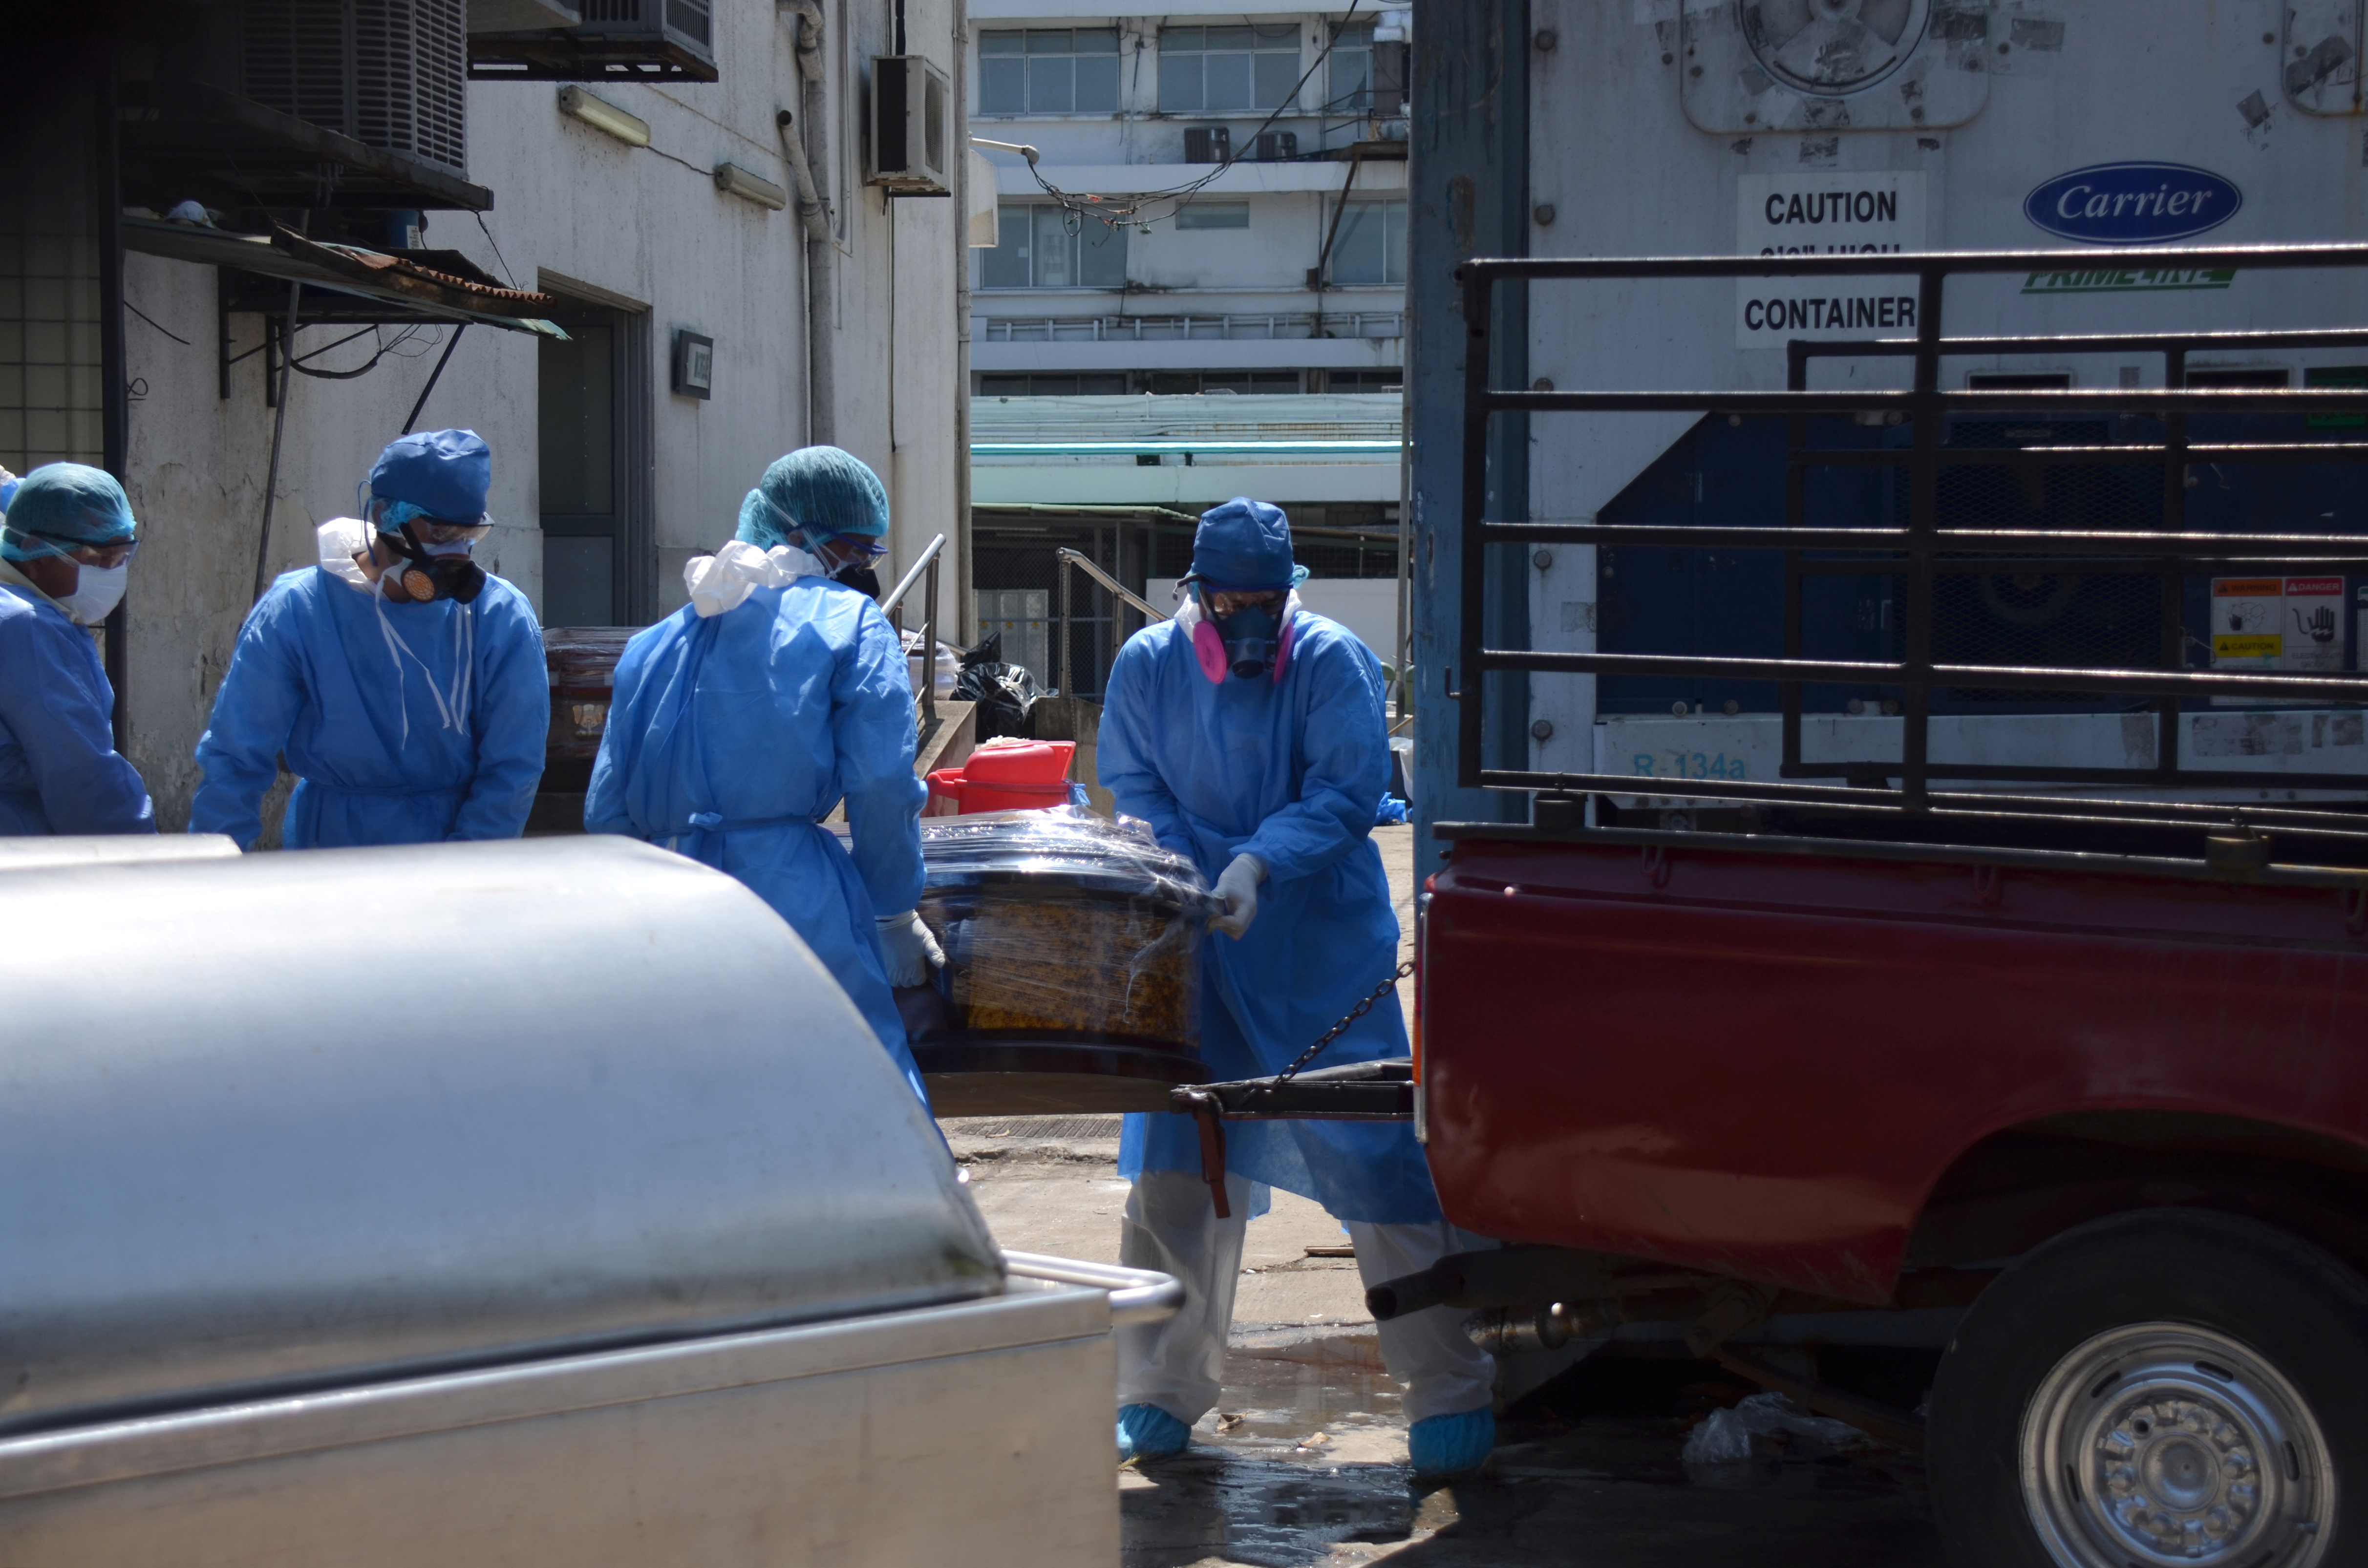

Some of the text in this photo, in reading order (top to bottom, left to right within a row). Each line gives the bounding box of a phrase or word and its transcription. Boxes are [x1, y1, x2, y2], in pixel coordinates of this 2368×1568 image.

[1765, 191, 1896, 225] CAUTION
[2056, 183, 2213, 219] Carrier
[1744, 297, 1915, 331] CONTAINER
[2231, 584, 2276, 592] WARNING
[2298, 583, 2340, 592] DANGER
